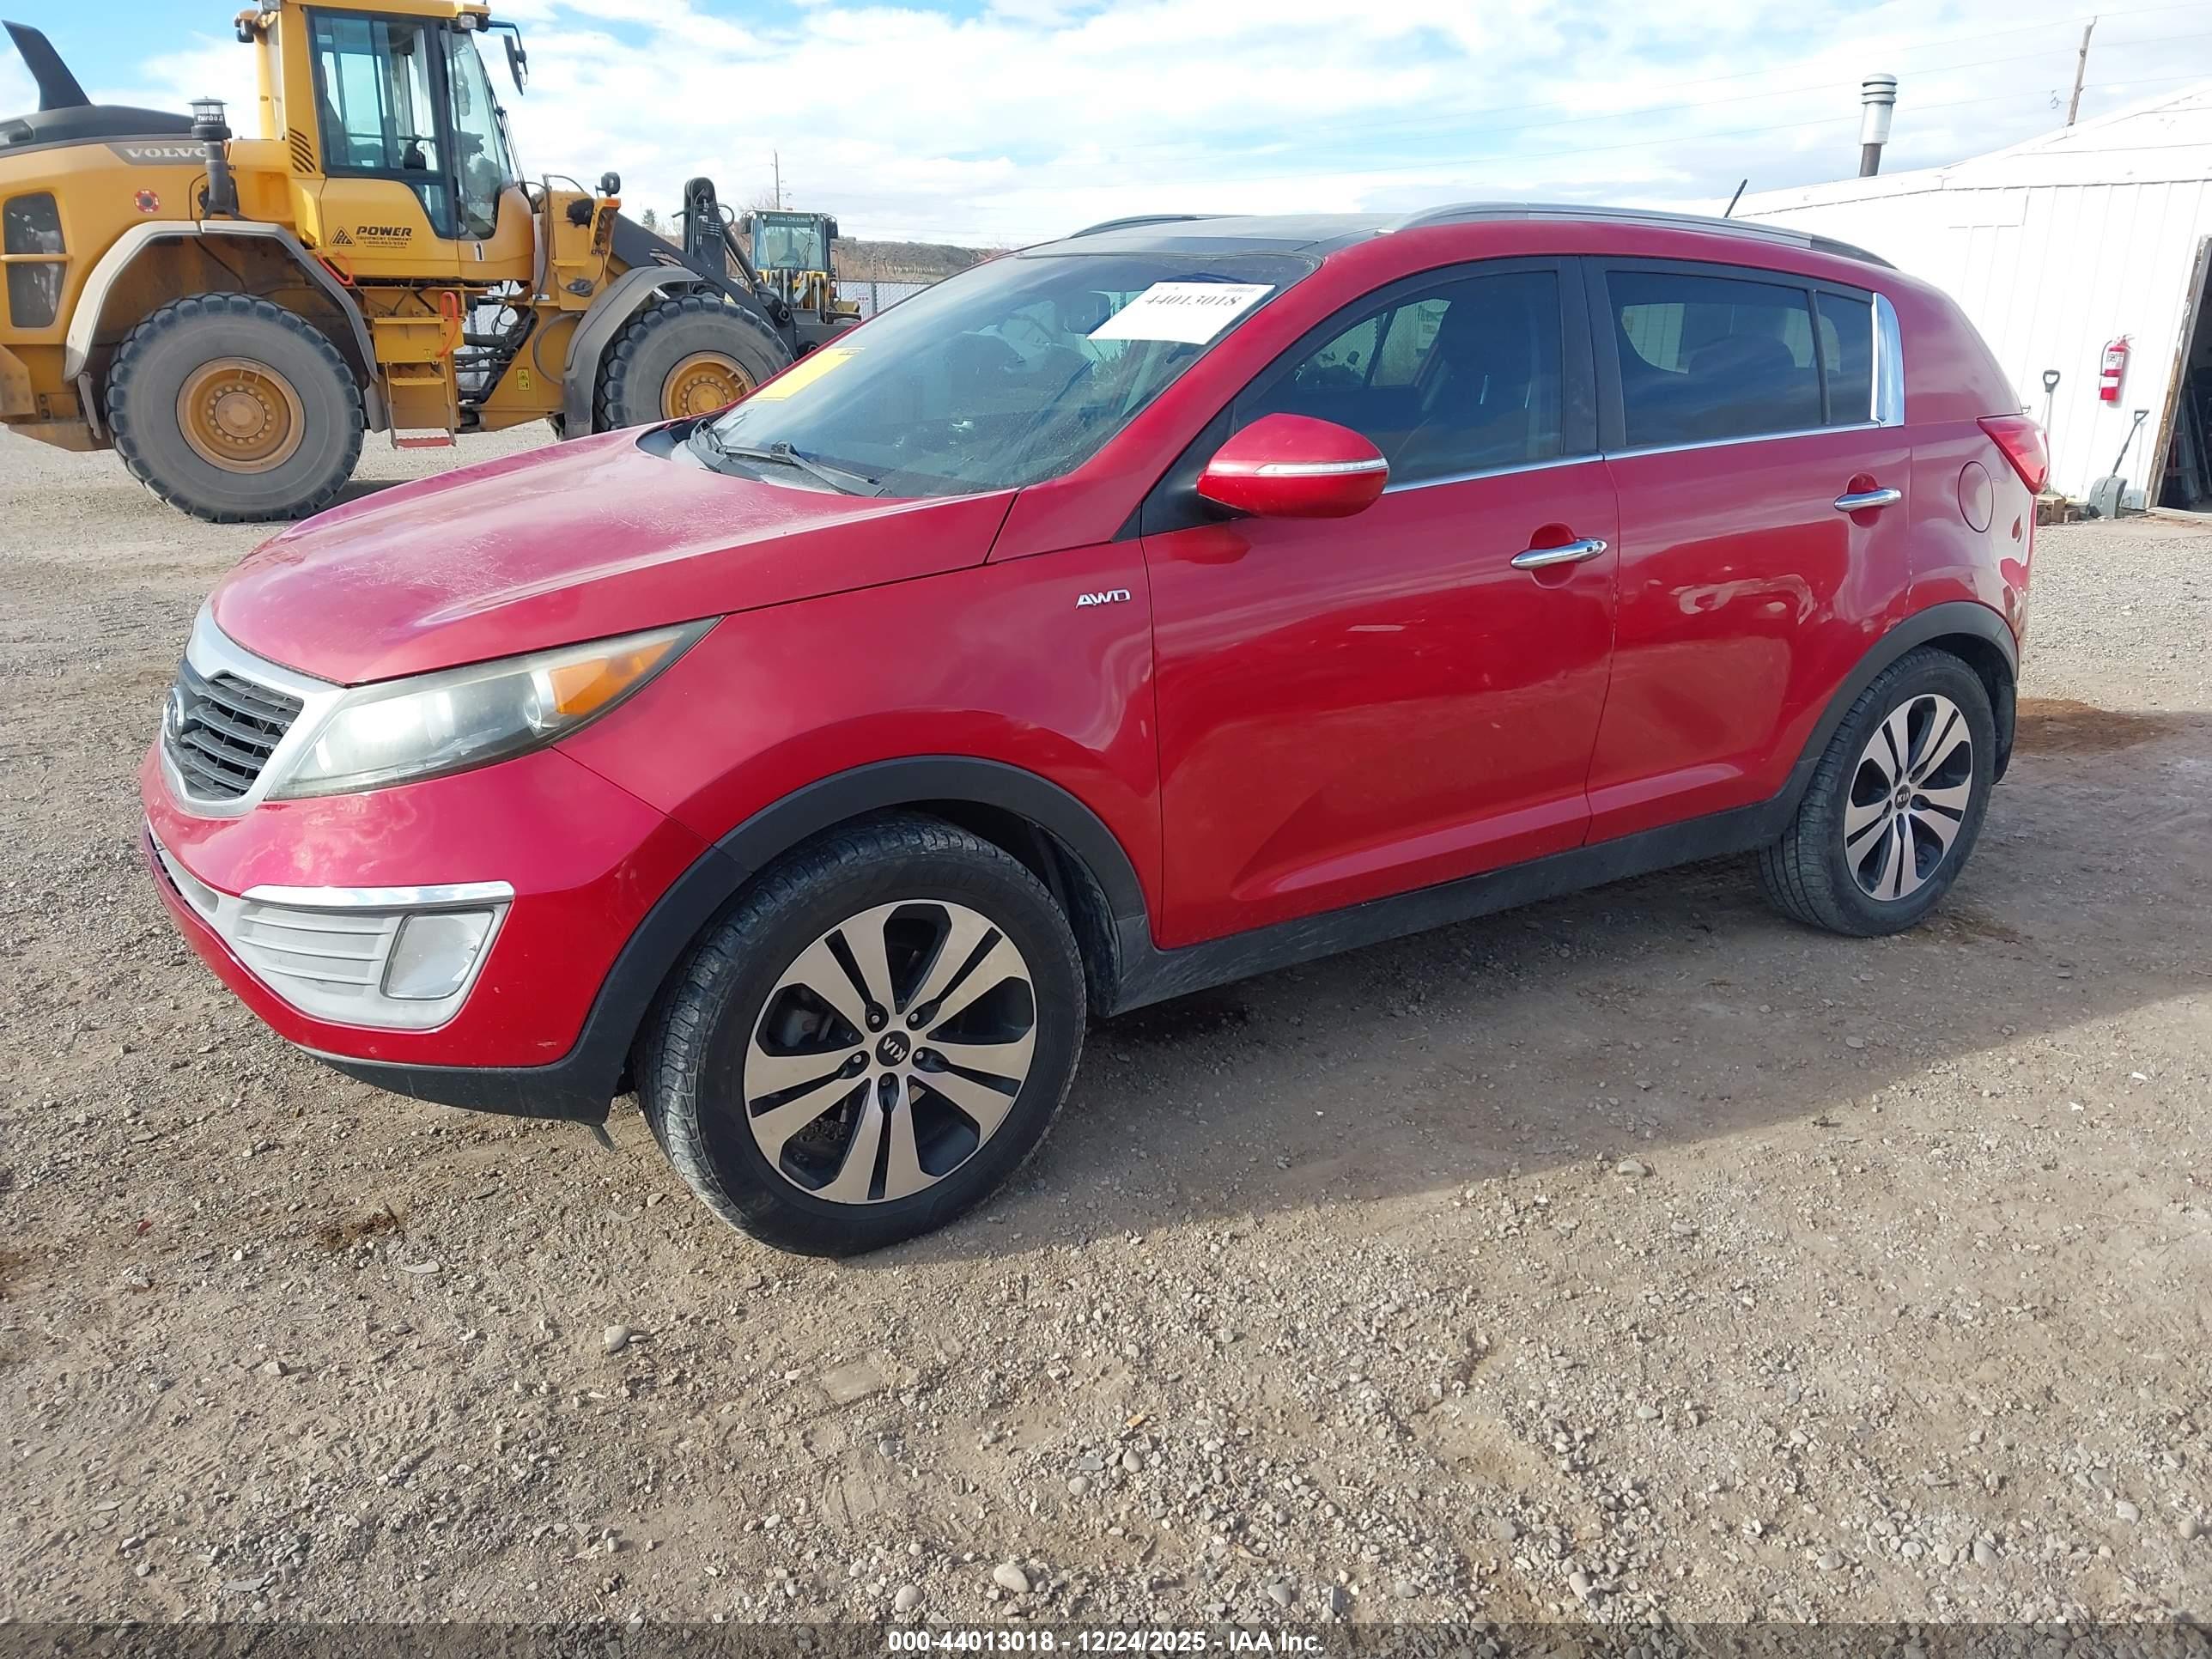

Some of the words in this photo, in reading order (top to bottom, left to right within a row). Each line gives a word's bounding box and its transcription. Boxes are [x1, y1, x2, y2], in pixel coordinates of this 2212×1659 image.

[356, 226, 412, 237] POWER
[1145, 295, 1242, 306] 44013018
[1075, 588, 1131, 609] AWD
[1897, 793, 1910, 803] KIA
[883, 1036, 907, 1061] KIA
